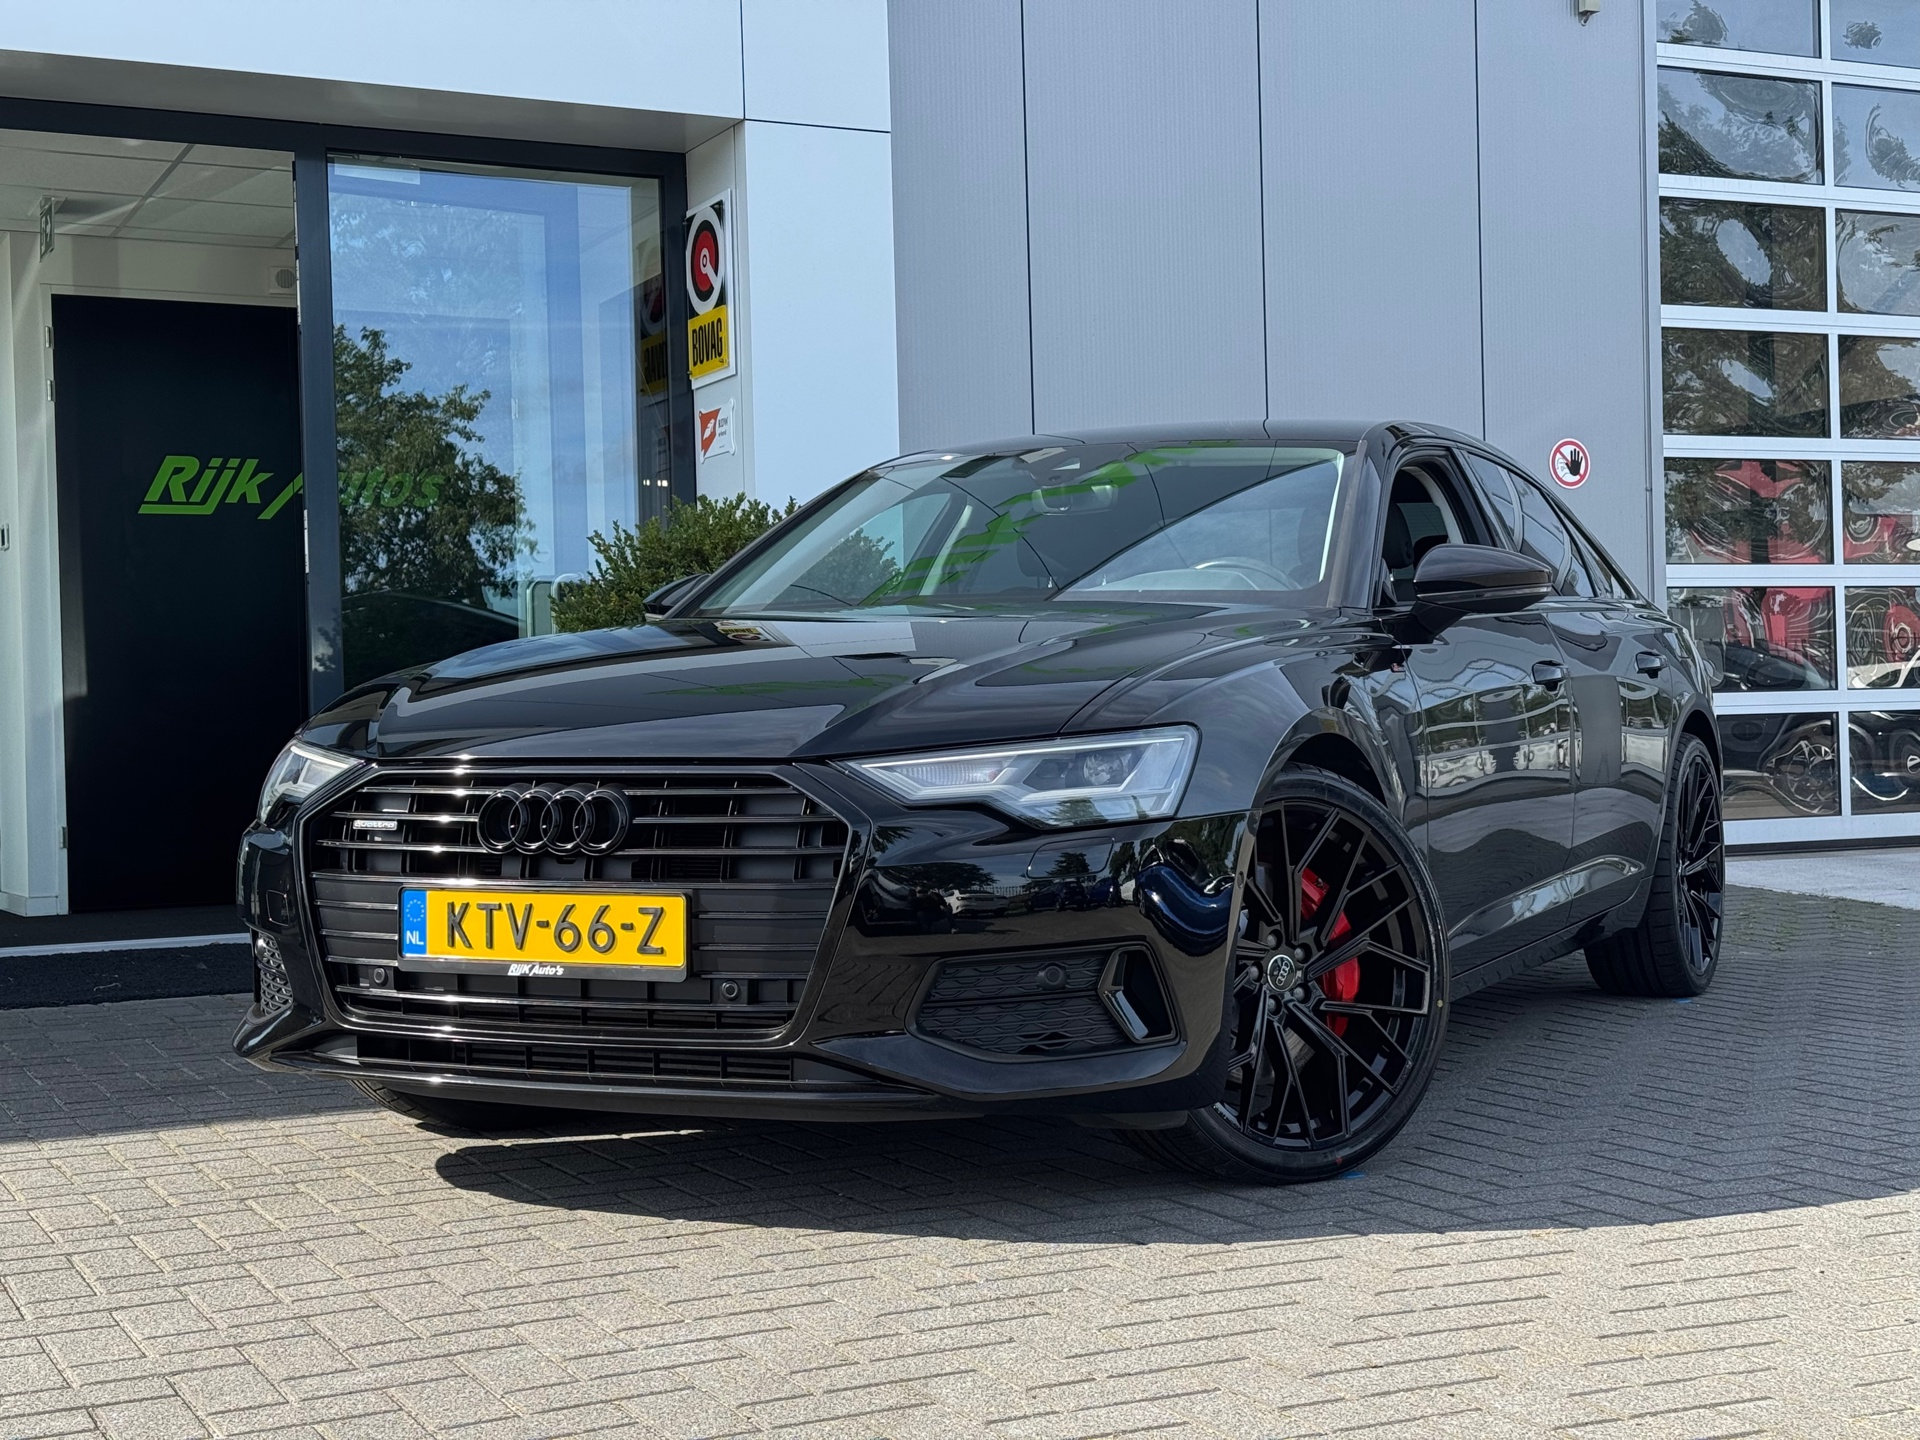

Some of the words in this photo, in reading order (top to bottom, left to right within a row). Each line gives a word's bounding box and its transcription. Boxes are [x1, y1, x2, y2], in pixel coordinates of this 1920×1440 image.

[692, 317, 723, 367] BOVAG
[138, 455, 274, 515] Rijk
[406, 930, 425, 946] NL
[447, 901, 665, 955] KTV-66-Z
[529, 964, 565, 977] Auto's
